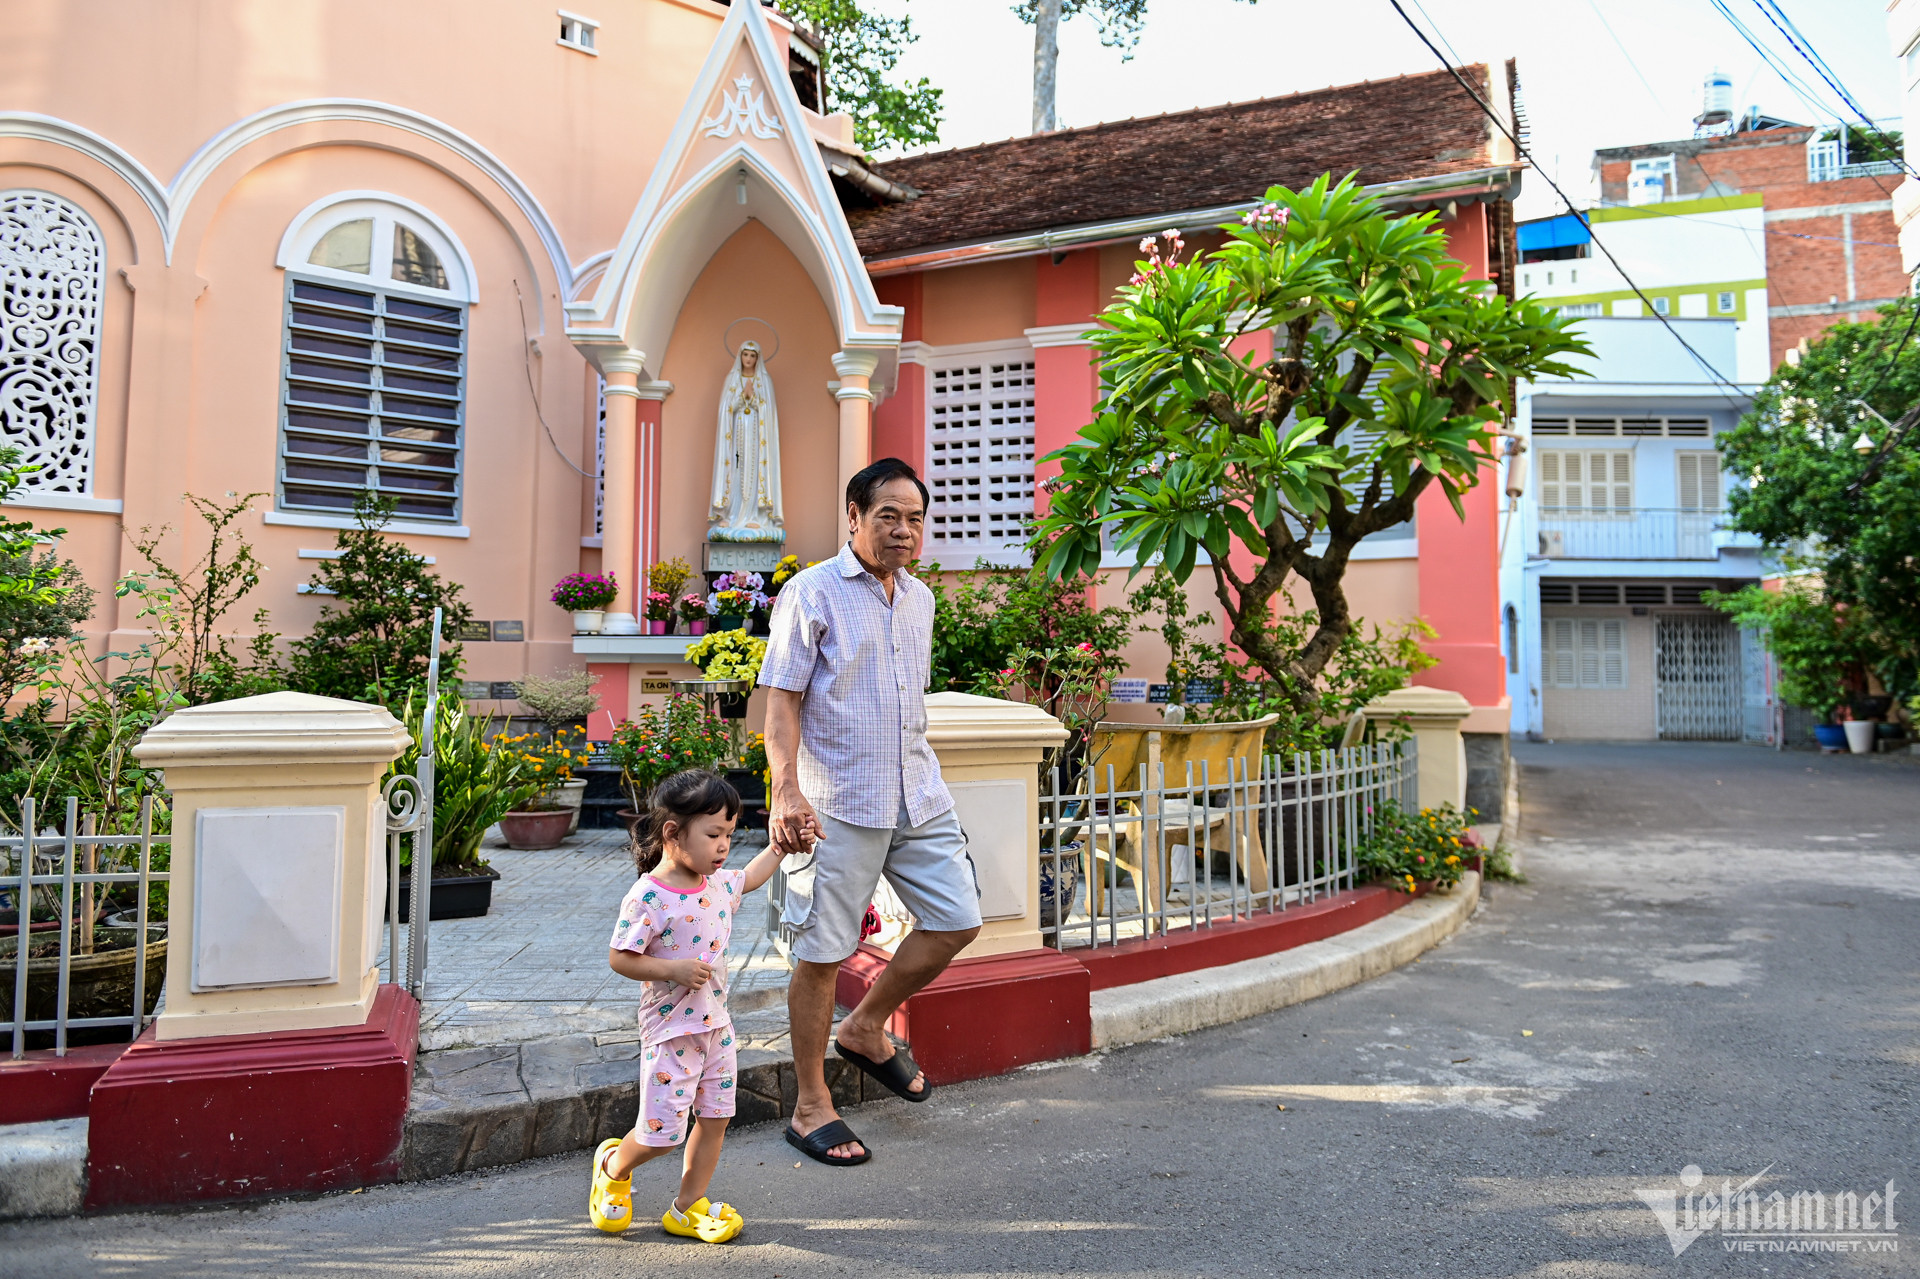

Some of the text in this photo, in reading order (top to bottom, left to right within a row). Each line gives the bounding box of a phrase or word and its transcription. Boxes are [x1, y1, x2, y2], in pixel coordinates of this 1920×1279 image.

[710, 549, 779, 567] AVE MARIA
[645, 682, 656, 691] TẠ
